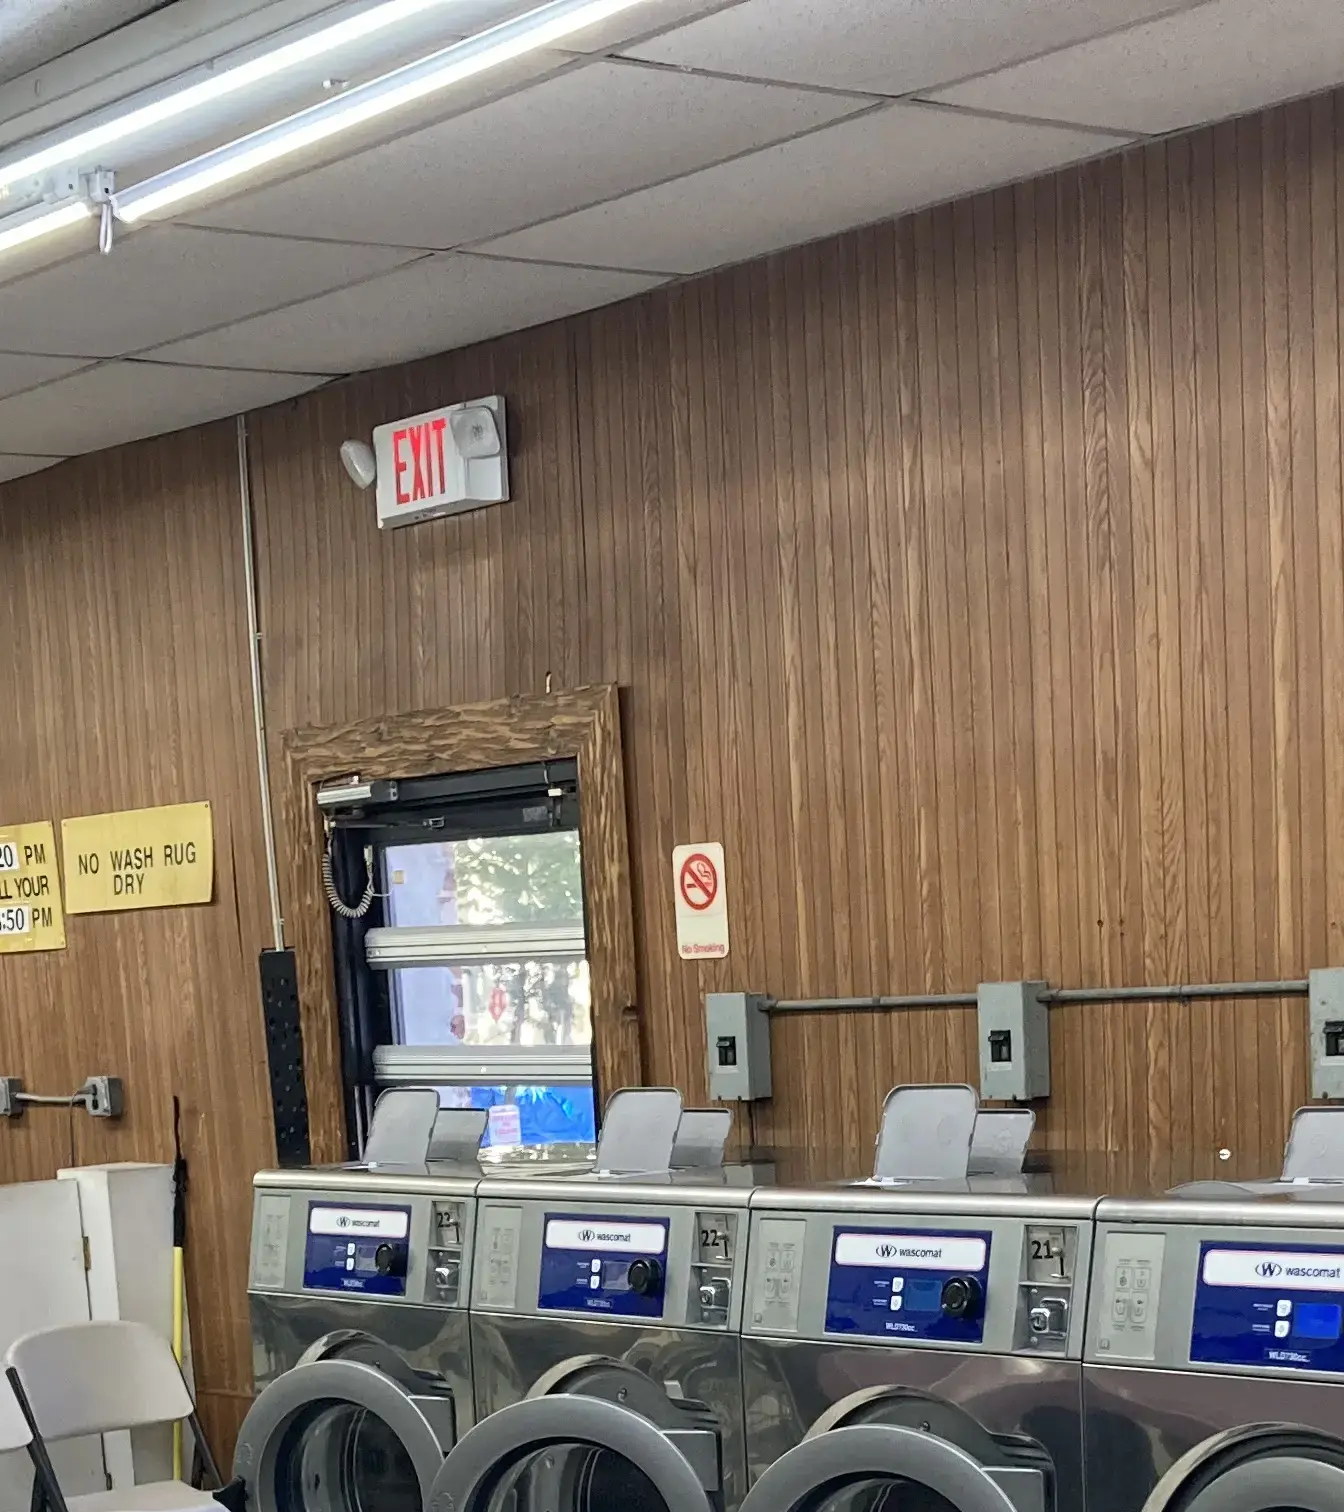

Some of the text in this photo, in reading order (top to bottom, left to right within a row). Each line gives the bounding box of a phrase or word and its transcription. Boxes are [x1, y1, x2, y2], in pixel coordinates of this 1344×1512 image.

[392, 417, 447, 505] EXIT
[24, 843, 47, 866] PM
[78, 841, 197, 876] NO WASH RUG
[14, 875, 50, 898] YOUR
[113, 873, 145, 897] DRY
[32, 907, 53, 929] PM
[682, 943, 725, 955] No Smoking
[351, 1219, 380, 1228] wascomat
[596, 1232, 632, 1243] wascomat
[700, 1229, 720, 1248] 22
[899, 1247, 943, 1258] wascomat
[1030, 1239, 1054, 1260] 21
[1285, 1267, 1342, 1279] wascomat
